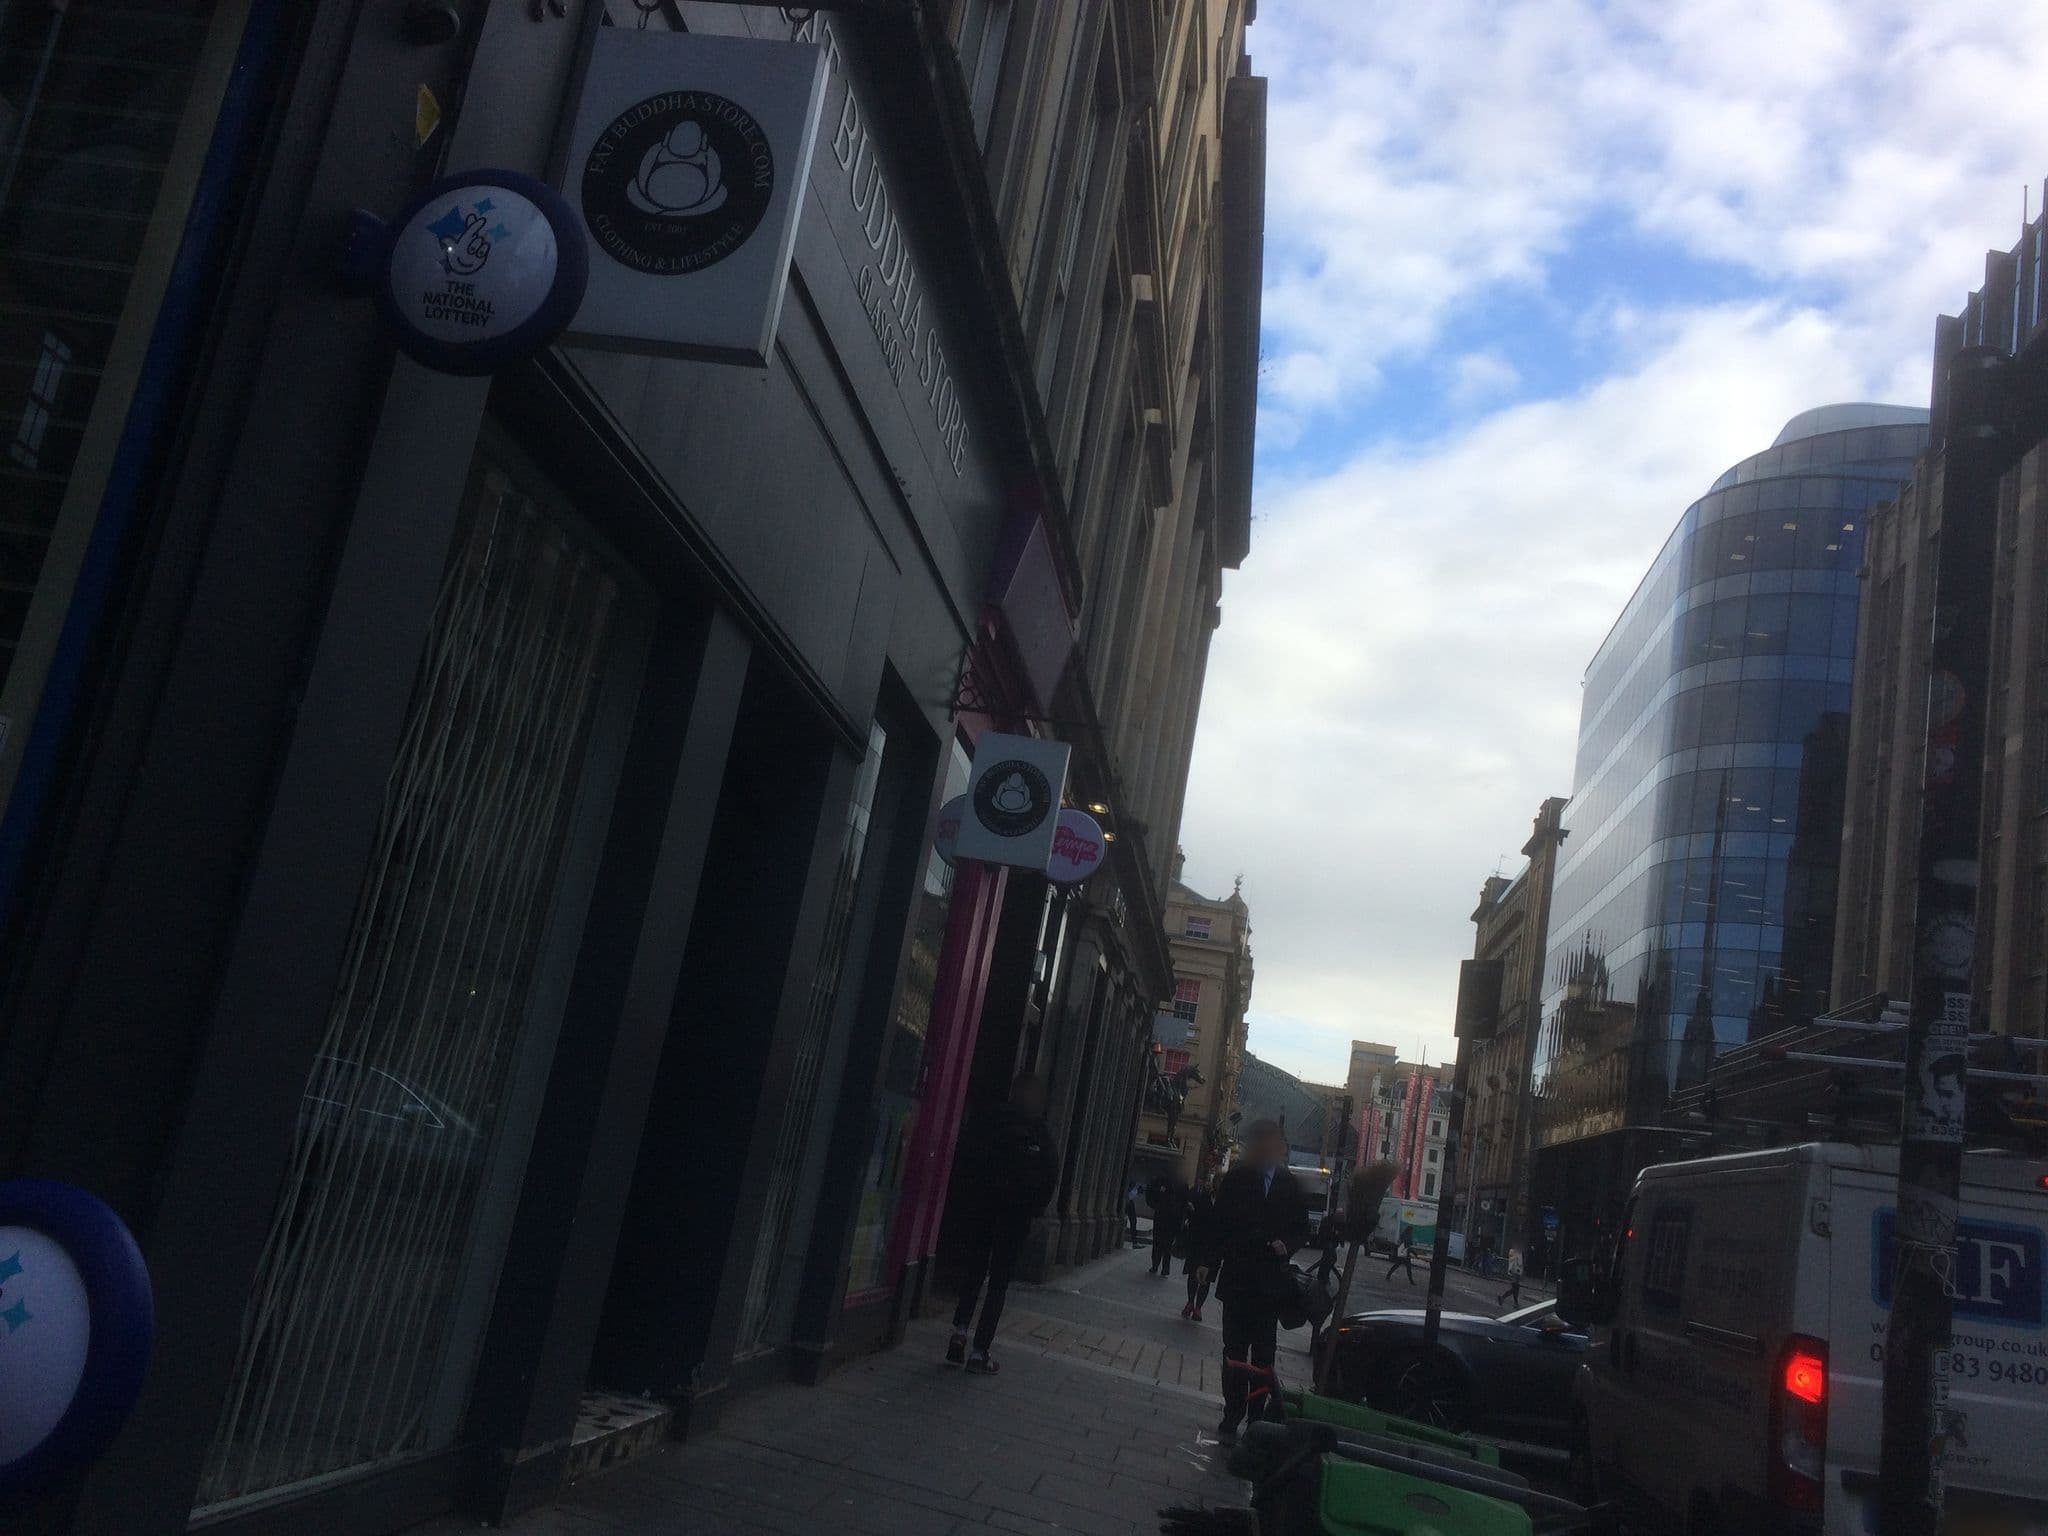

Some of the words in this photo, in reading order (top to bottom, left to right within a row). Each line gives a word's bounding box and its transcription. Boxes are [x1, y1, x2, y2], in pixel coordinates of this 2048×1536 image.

[613, 94, 697, 140] BUDDHA
[594, 213, 652, 268] CLOTHING
[654, 256, 666, 271] &
[670, 221, 744, 270] LIFESTYLE
[445, 280, 475, 297] THE
[831, 79, 923, 361] BUDDHA
[918, 328, 970, 478] STORE
[422, 291, 496, 316] NATIONAL
[424, 305, 490, 327] LOTTERY
[1988, 1359, 2048, 1386] 9480
